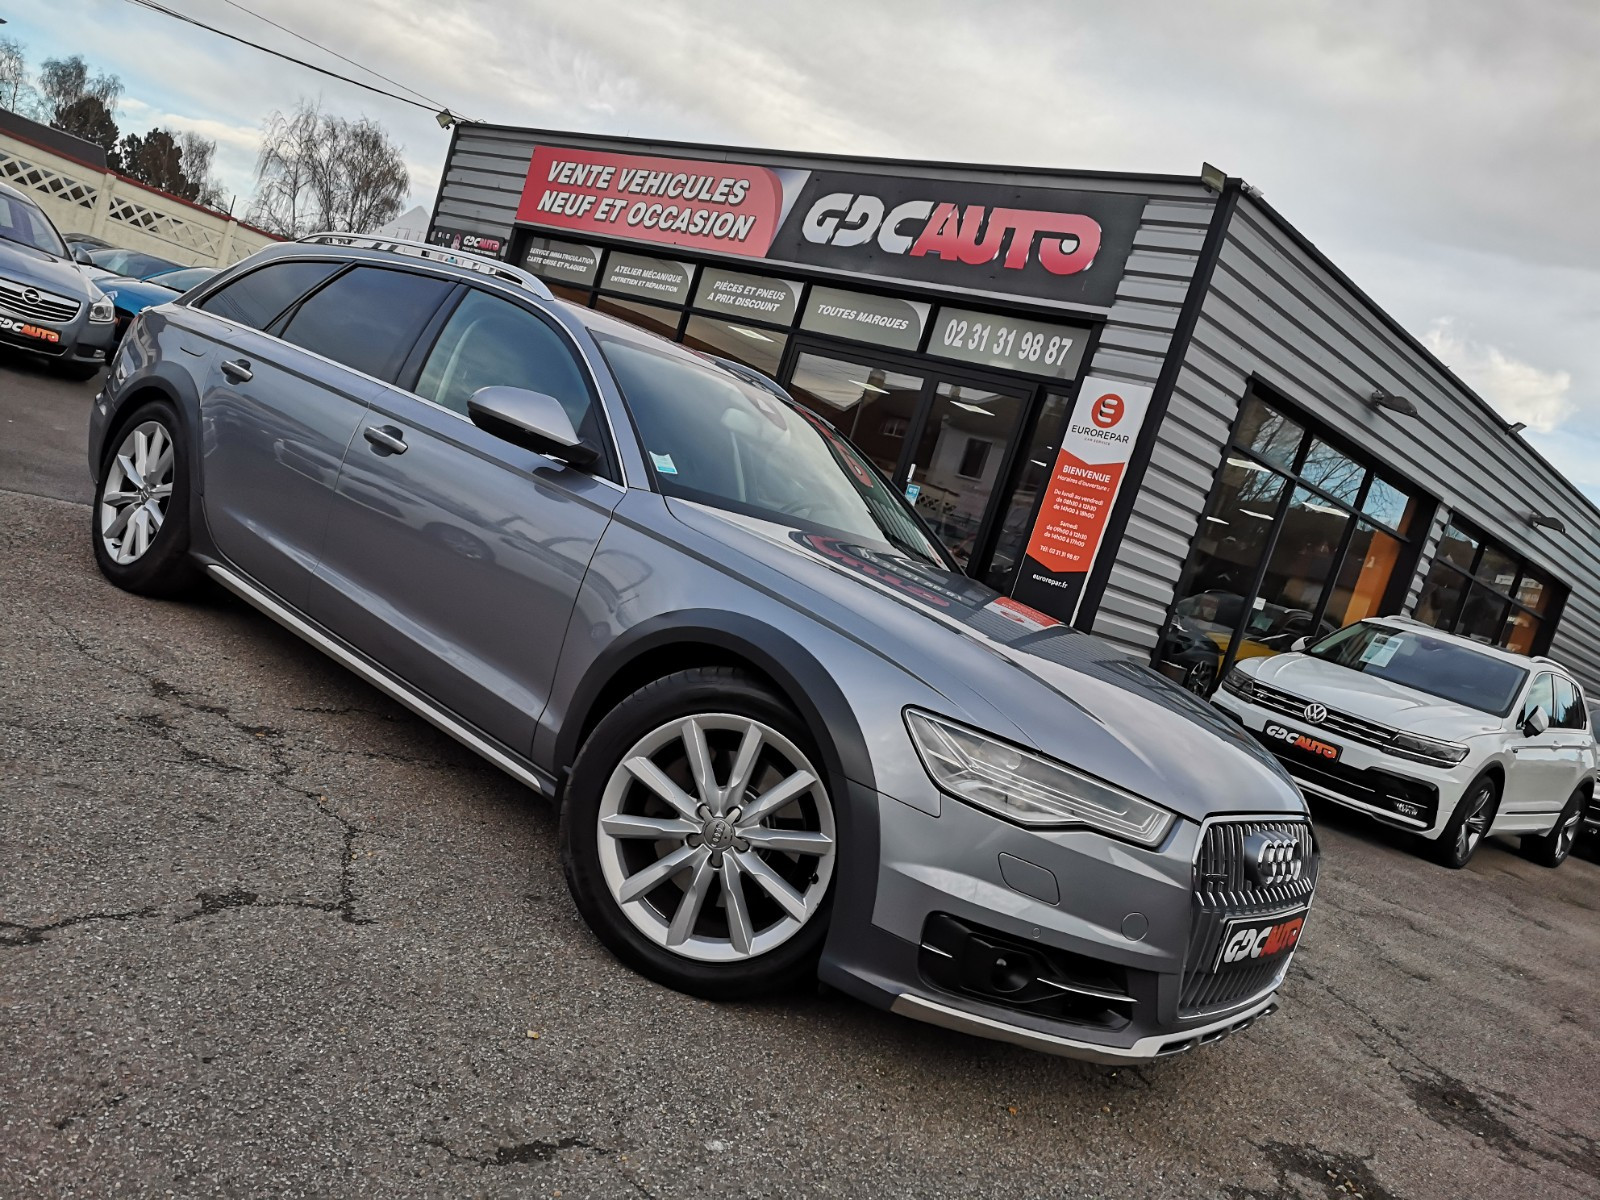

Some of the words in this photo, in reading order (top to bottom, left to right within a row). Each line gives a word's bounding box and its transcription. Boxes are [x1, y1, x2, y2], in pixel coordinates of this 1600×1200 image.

[547, 160, 616, 188] VENTE
[617, 168, 750, 205] VEHICULES
[537, 190, 596, 217] NEUF
[594, 198, 628, 222] ET
[627, 202, 755, 241] OCCASION
[526, 255, 543, 263] CARTE
[542, 258, 557, 267] GRISE
[563, 263, 588, 272] PLAQUES
[529, 247, 550, 256] SERVICE
[549, 251, 595, 265] IMMATRICULATION
[614, 265, 642, 277] ATELIER
[642, 268, 683, 283] MÉCANIQUE
[610, 275, 638, 286] ENTRETIEN
[645, 280, 679, 293] RÉPARATION
[707, 292, 715, 300] A
[714, 293, 736, 304] PRIX
[735, 298, 780, 312] DISCOUNT
[743, 286, 757, 295] ET
[755, 289, 786, 301] PNEUS
[817, 304, 857, 321] TOUTES
[856, 312, 909, 330] MARQUES
[943, 319, 967, 347] 02
[968, 322, 991, 352] 31
[992, 327, 1016, 357] 31
[1018, 331, 1045, 362] 98
[1044, 336, 1074, 366] 87
[1071, 425, 1130, 444] EUROREPAR
[1057, 474, 1078, 485] Horaires
[1062, 465, 1111, 483] BIENVENUE
[1061, 490, 1075, 498] lundi
[1081, 496, 1104, 506] vendredi
[1060, 505, 1076, 514] 14h00
[1082, 503, 1097, 512] 12h30
[1059, 520, 1079, 530] Samedi
[1032, 573, 1068, 589] eurorepar.fr
